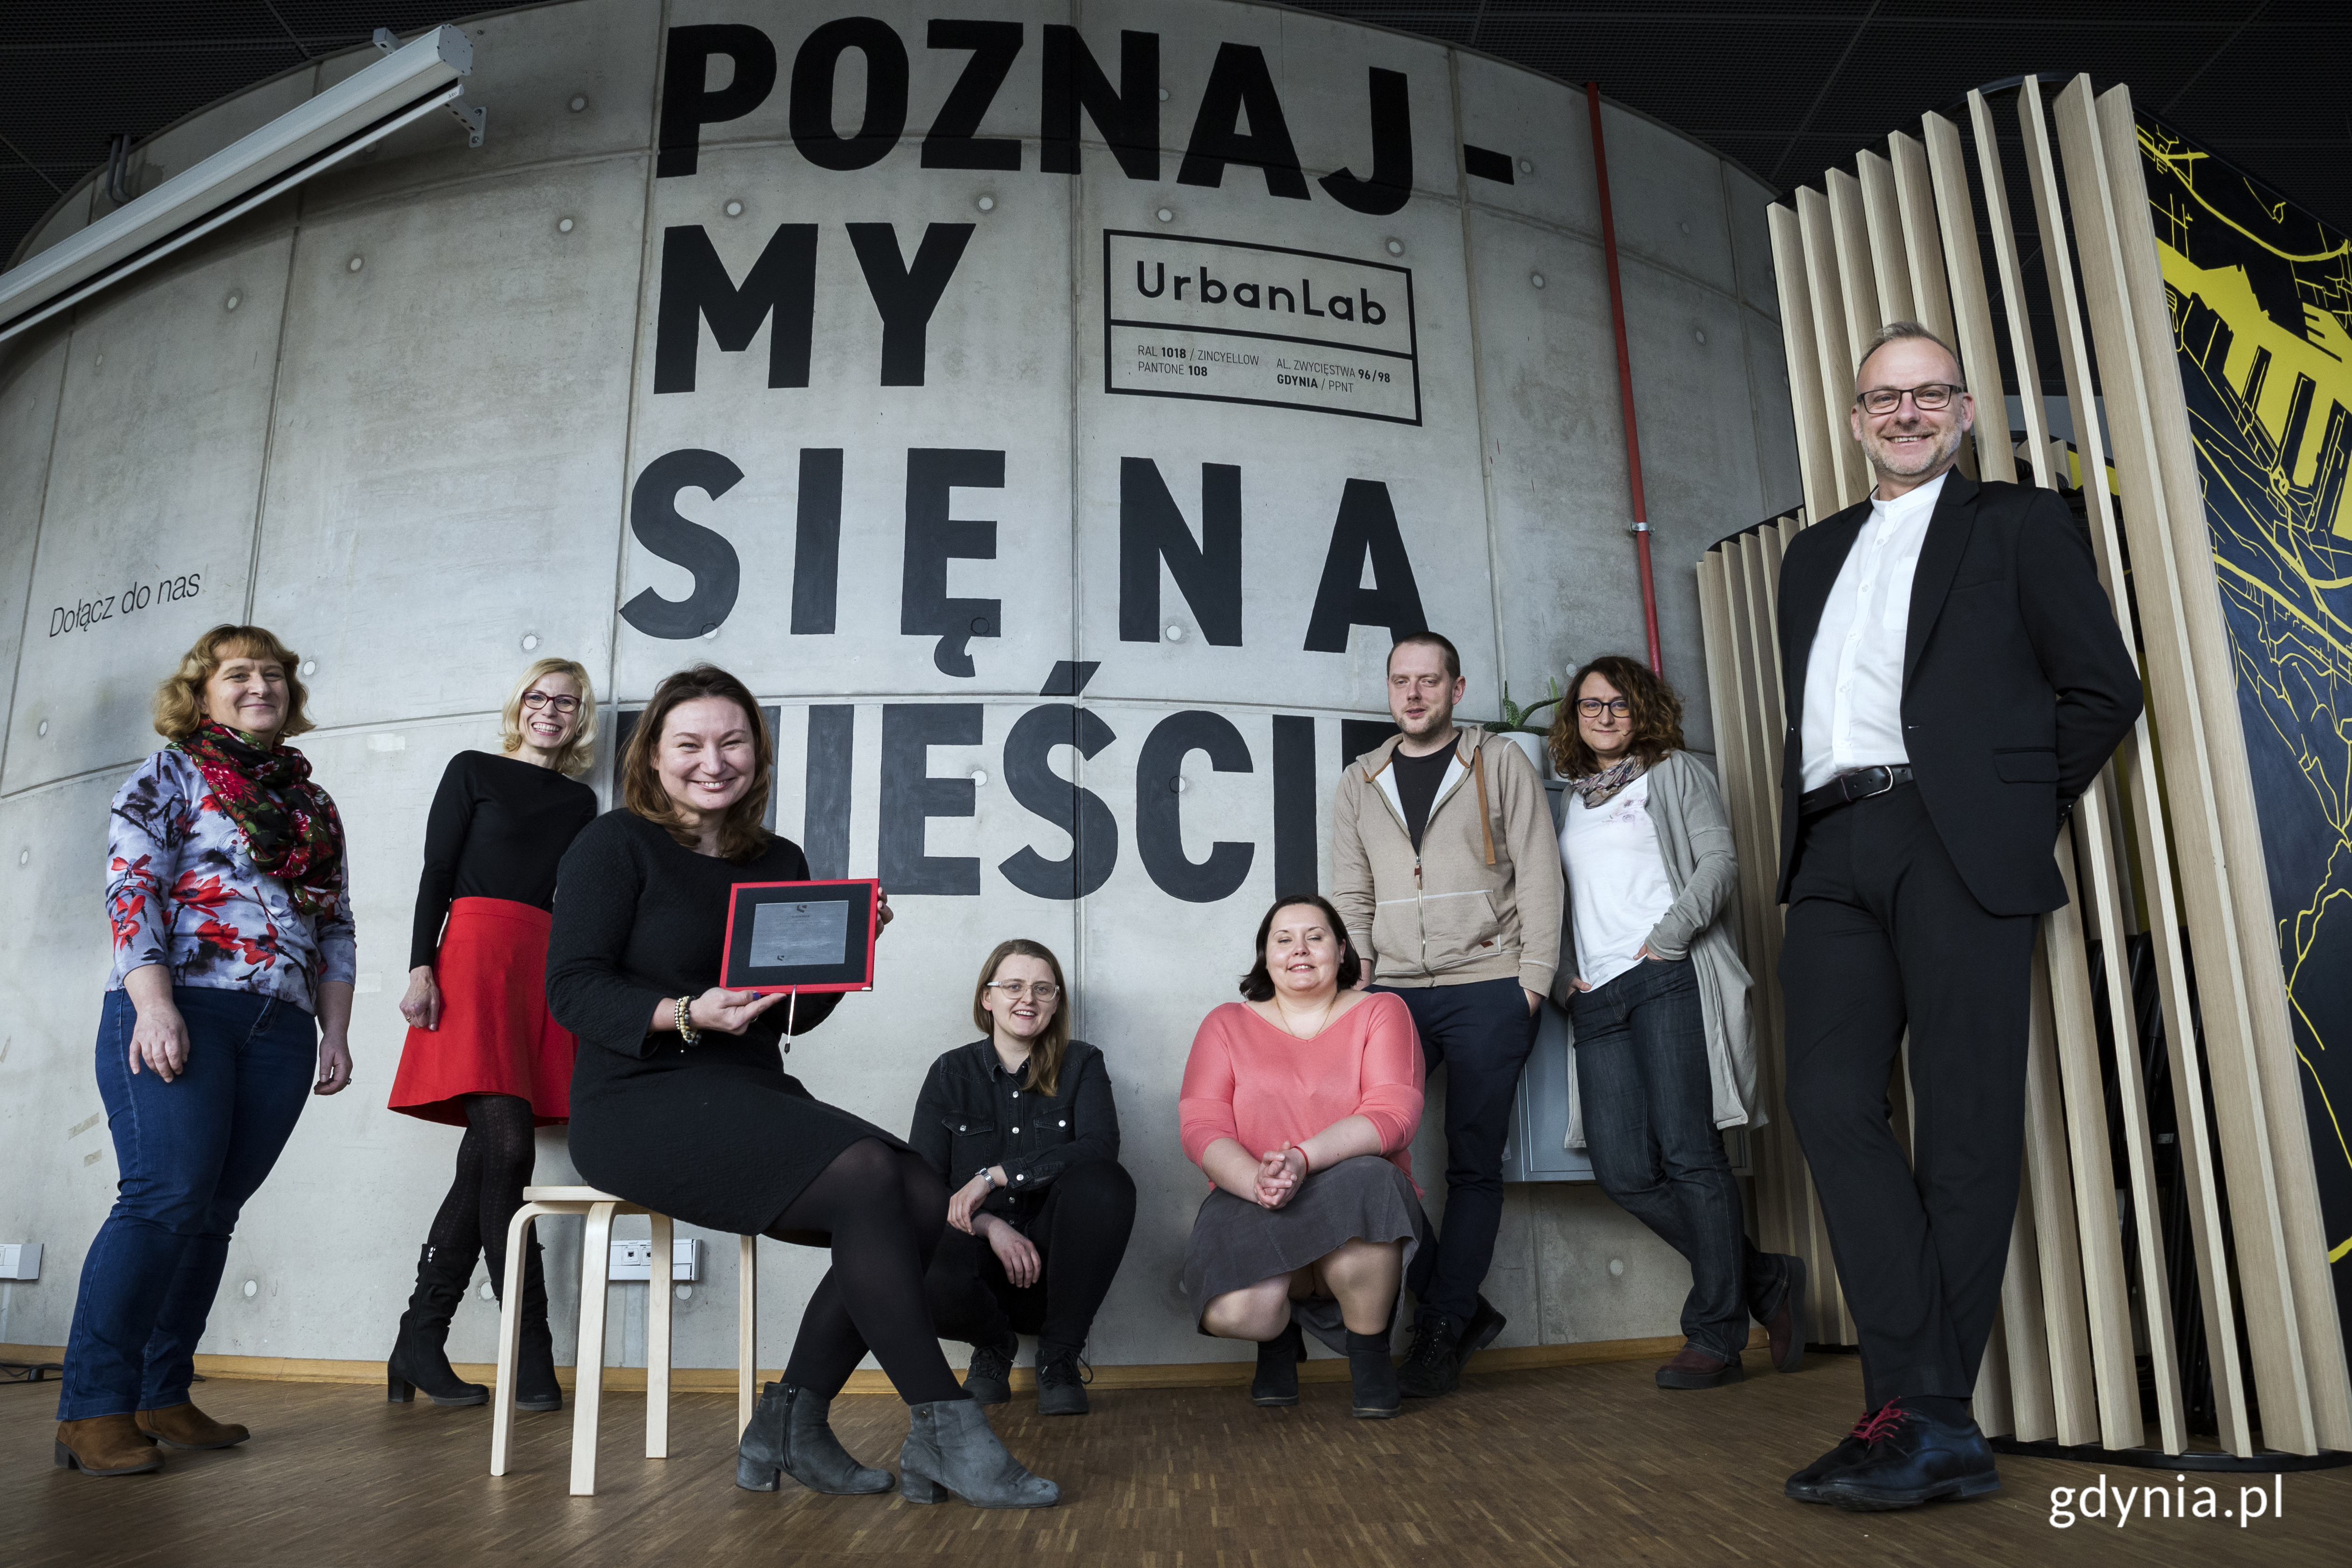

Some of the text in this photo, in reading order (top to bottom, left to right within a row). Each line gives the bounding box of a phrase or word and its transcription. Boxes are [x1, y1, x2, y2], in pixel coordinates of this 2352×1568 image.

[654, 223, 976, 395] MY
[1137, 260, 1386, 325] UrbanLab
[1138, 345, 1259, 366] RAL 1018 / ZINCYELLOW
[1138, 361, 1208, 377] PANTONE 108
[1276, 358, 1391, 383] AL. ZWYCIĘSTWA 96/98
[1276, 373, 1354, 393] GDYNIA / PPNT
[618, 448, 1430, 677] SIĘ NA
[49, 573, 200, 638] Dołącz do nas
[613, 661, 1402, 903] IEŚCI
